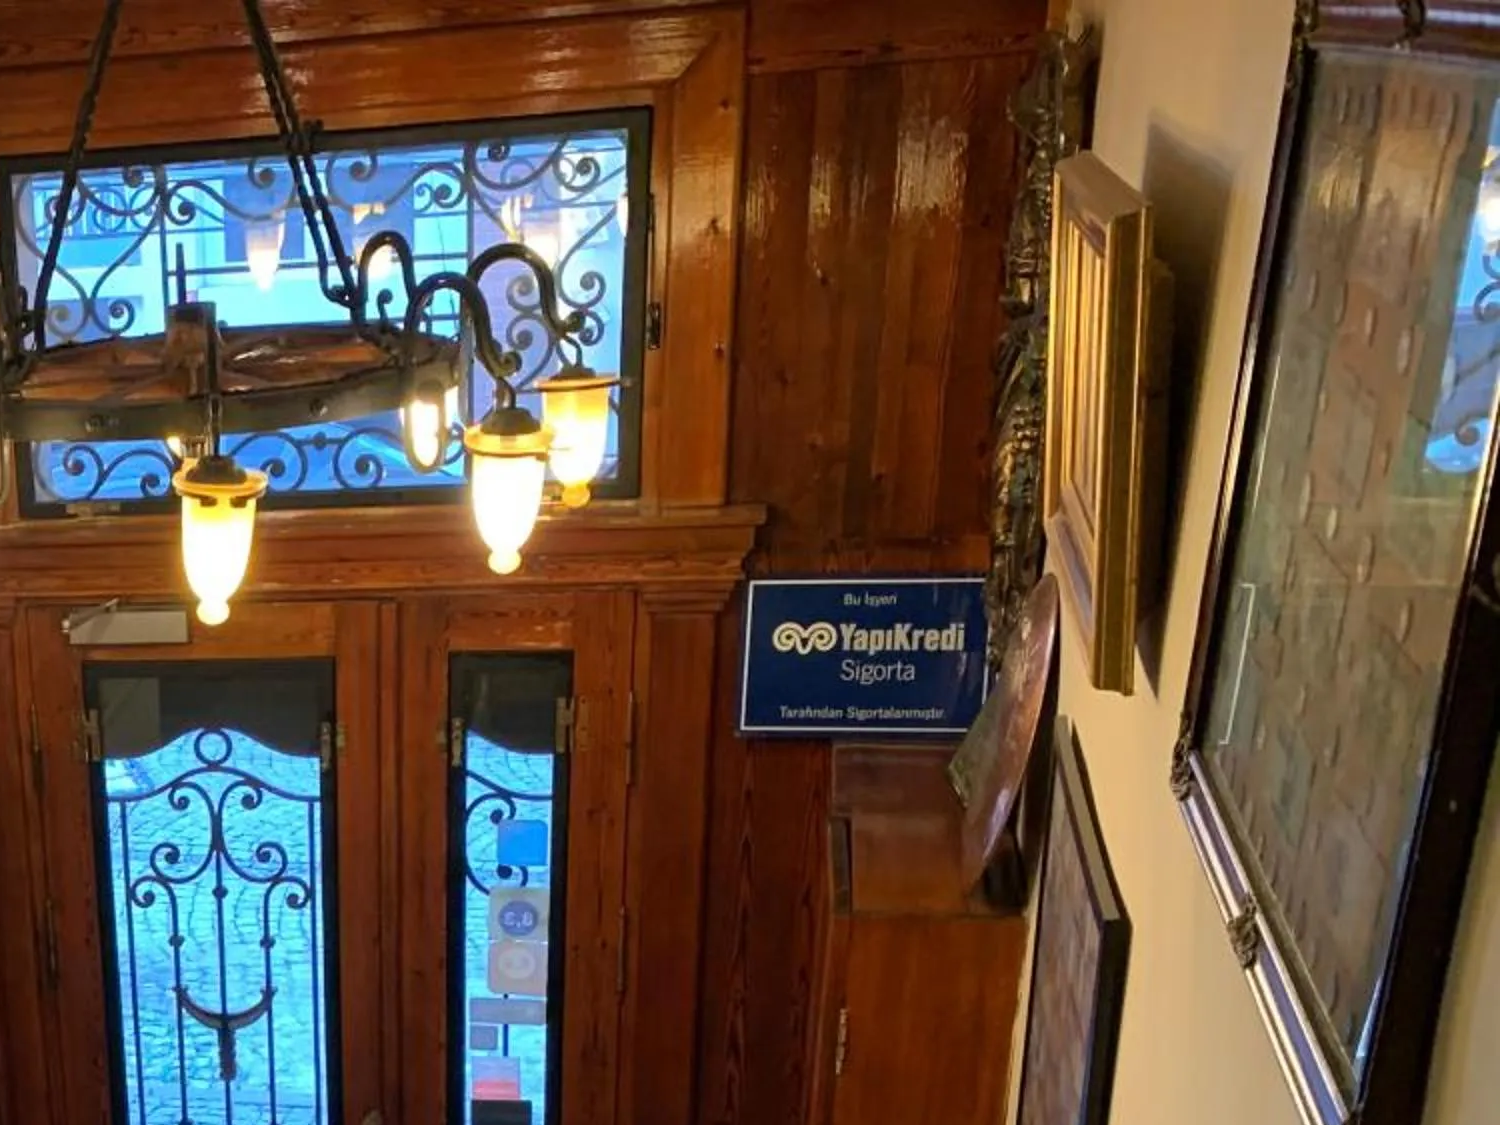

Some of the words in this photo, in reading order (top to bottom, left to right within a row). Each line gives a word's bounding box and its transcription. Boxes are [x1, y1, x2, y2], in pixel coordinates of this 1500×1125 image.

[843, 593, 861, 606] Bu
[839, 621, 966, 655] YapıKredi
[839, 659, 916, 685] Sigorta
